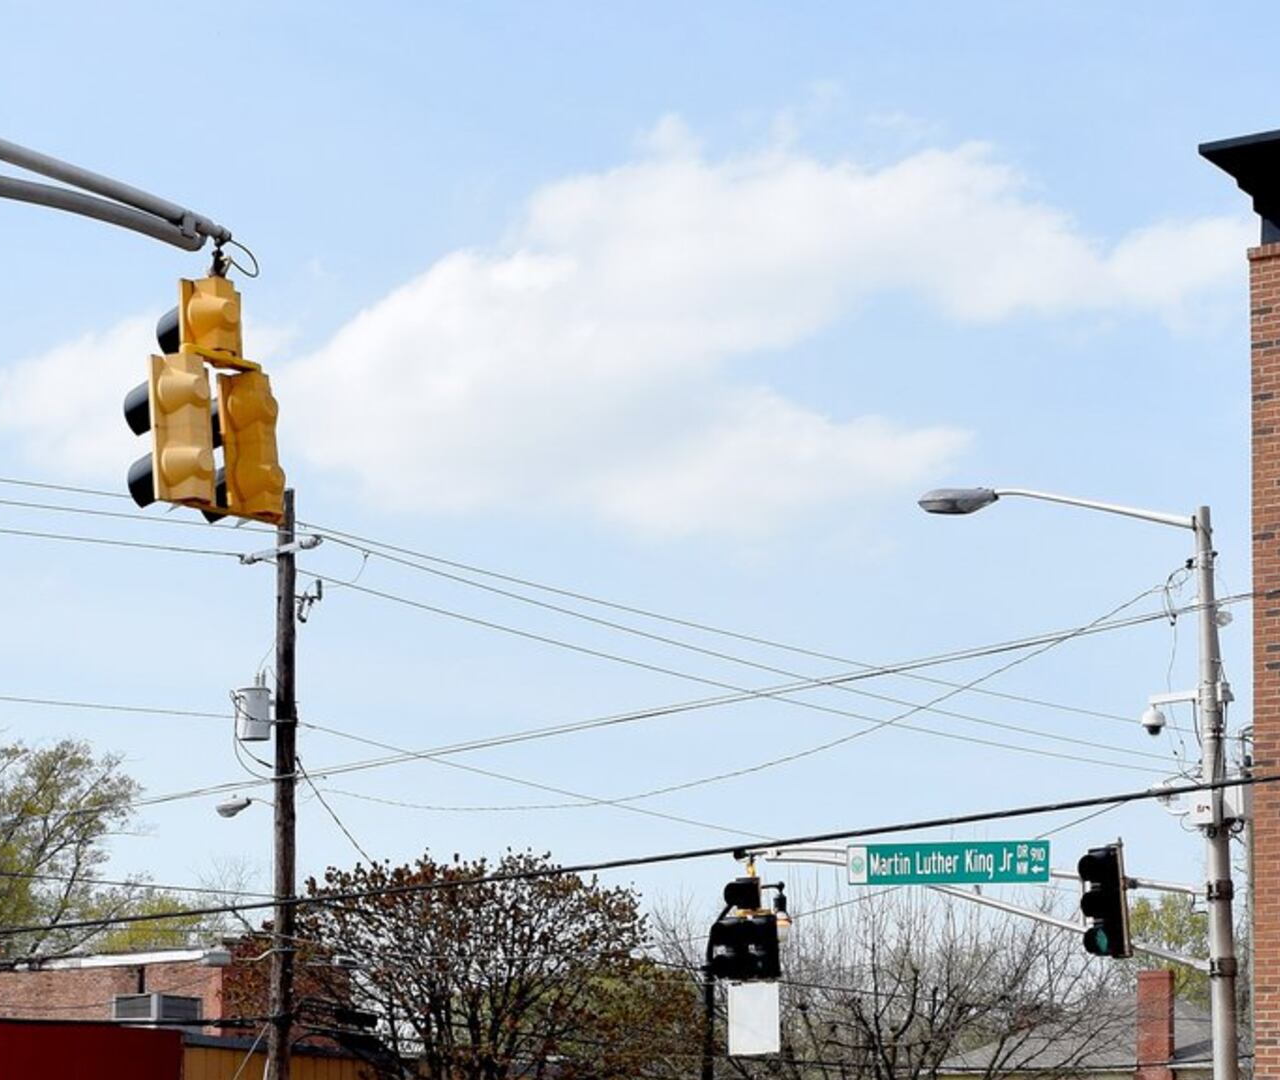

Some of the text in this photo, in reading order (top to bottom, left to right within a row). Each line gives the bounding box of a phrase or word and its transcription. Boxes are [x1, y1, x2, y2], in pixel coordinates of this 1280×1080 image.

[870, 847, 1013, 879] Martin Luther King Jr
